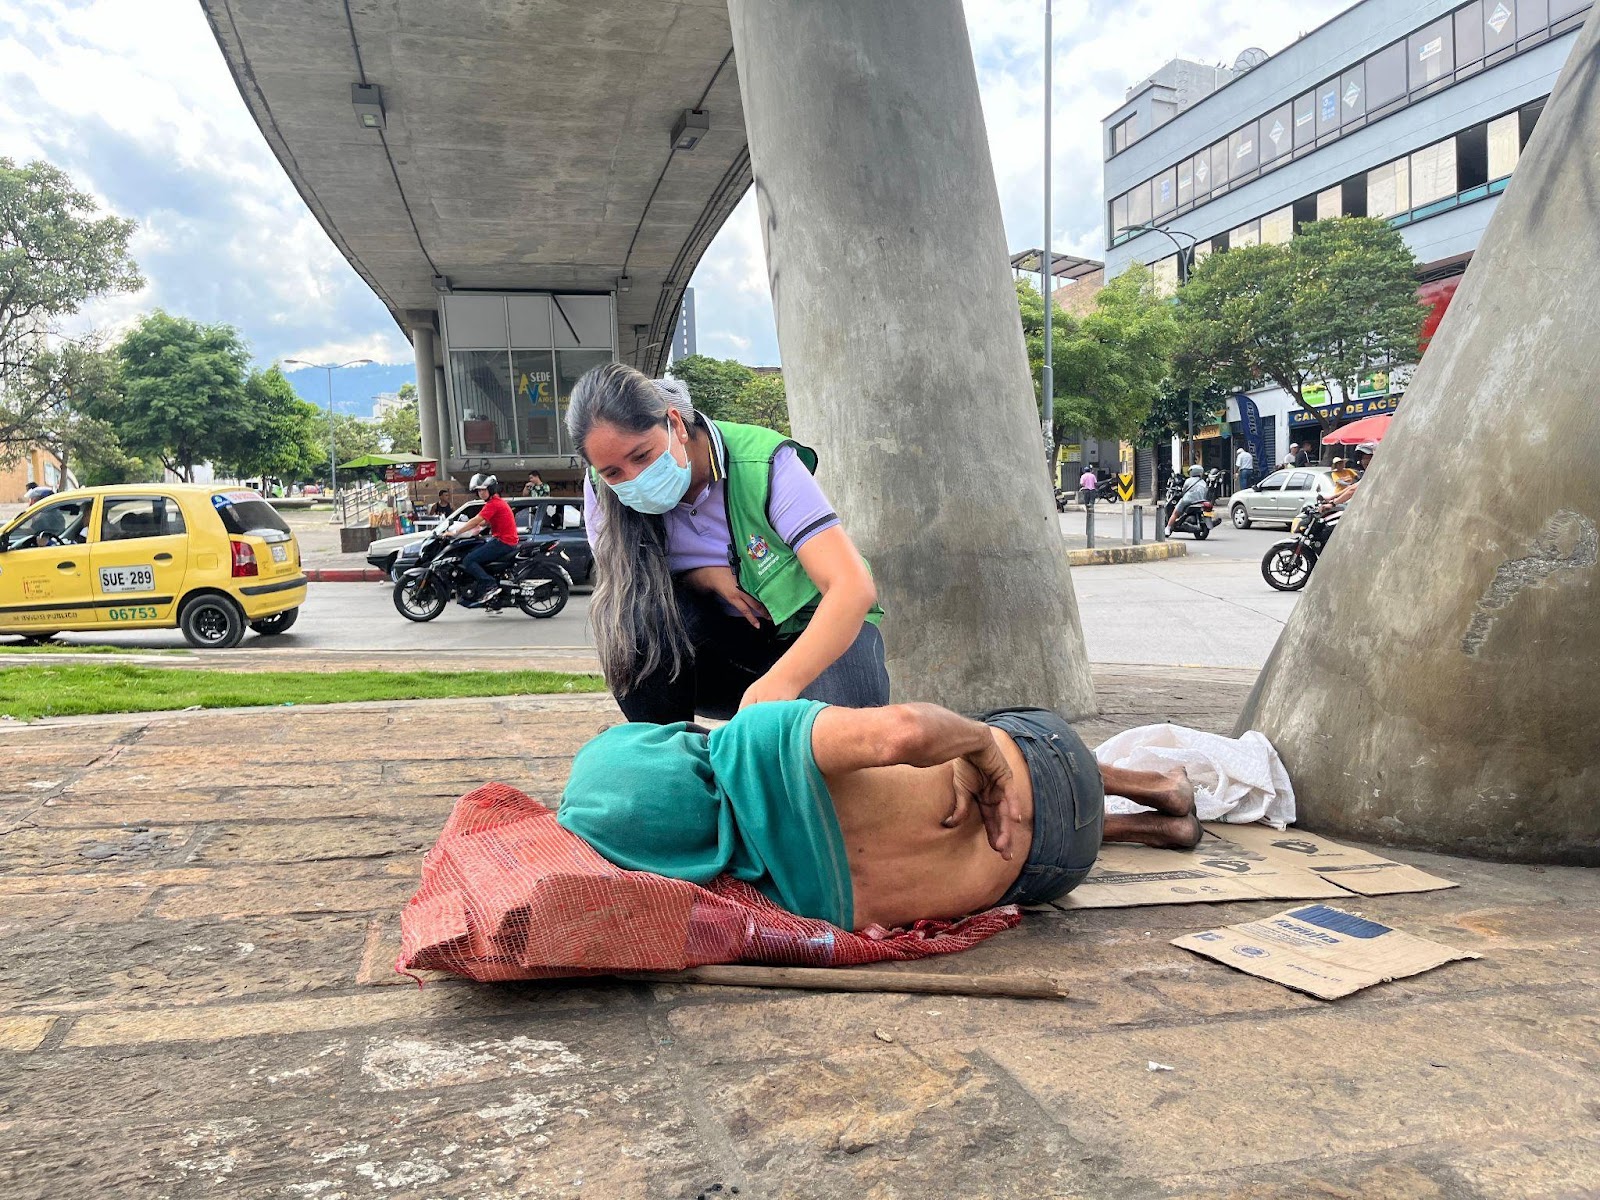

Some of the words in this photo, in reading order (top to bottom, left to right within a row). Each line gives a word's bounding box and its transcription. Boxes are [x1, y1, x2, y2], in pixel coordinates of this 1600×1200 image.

[530, 371, 551, 382] SEDE
[519, 373, 549, 406] AVC
[1346, 403, 1364, 414] DE
[1368, 397, 1402, 411] ACE
[102, 573, 125, 586] SUE
[130, 571, 151, 585] 289
[109, 607, 157, 620] 06753
